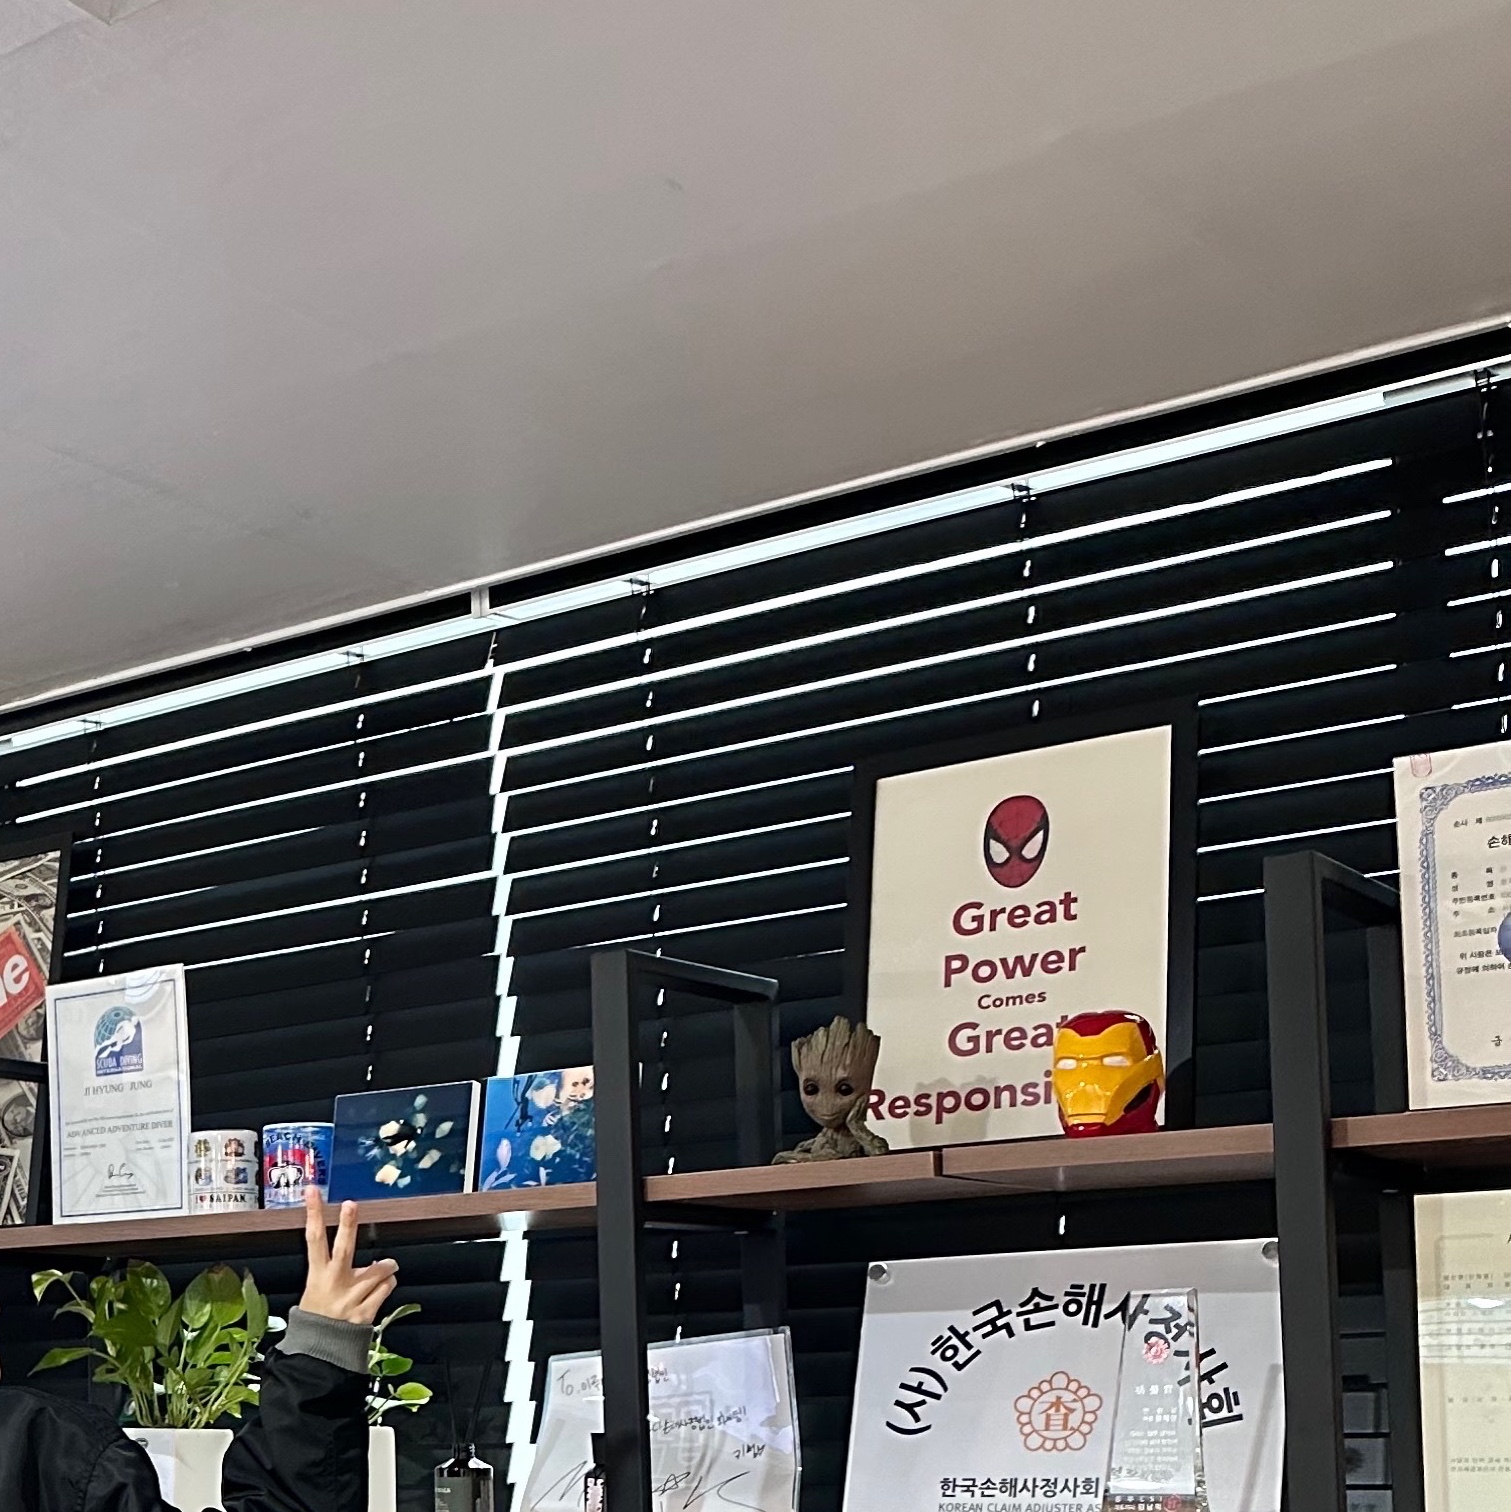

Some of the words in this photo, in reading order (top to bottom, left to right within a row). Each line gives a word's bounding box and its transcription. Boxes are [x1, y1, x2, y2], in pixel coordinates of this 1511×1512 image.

[952, 891, 1078, 937] Great
[943, 946, 1087, 988] Power
[976, 989, 1048, 1010] Comes
[96, 1057, 117, 1069] SCUBA
[119, 1053, 143, 1067] DIVING
[92, 1083, 125, 1095] HYUNG
[129, 1080, 153, 1092] JUNG
[67, 1126, 107, 1139] ADVANCED
[108, 1121, 149, 1134] ADVENTURE
[209, 1193, 247, 1204] SAIPAN
[939, 1476, 1100, 1500] 한국손해사정사회
